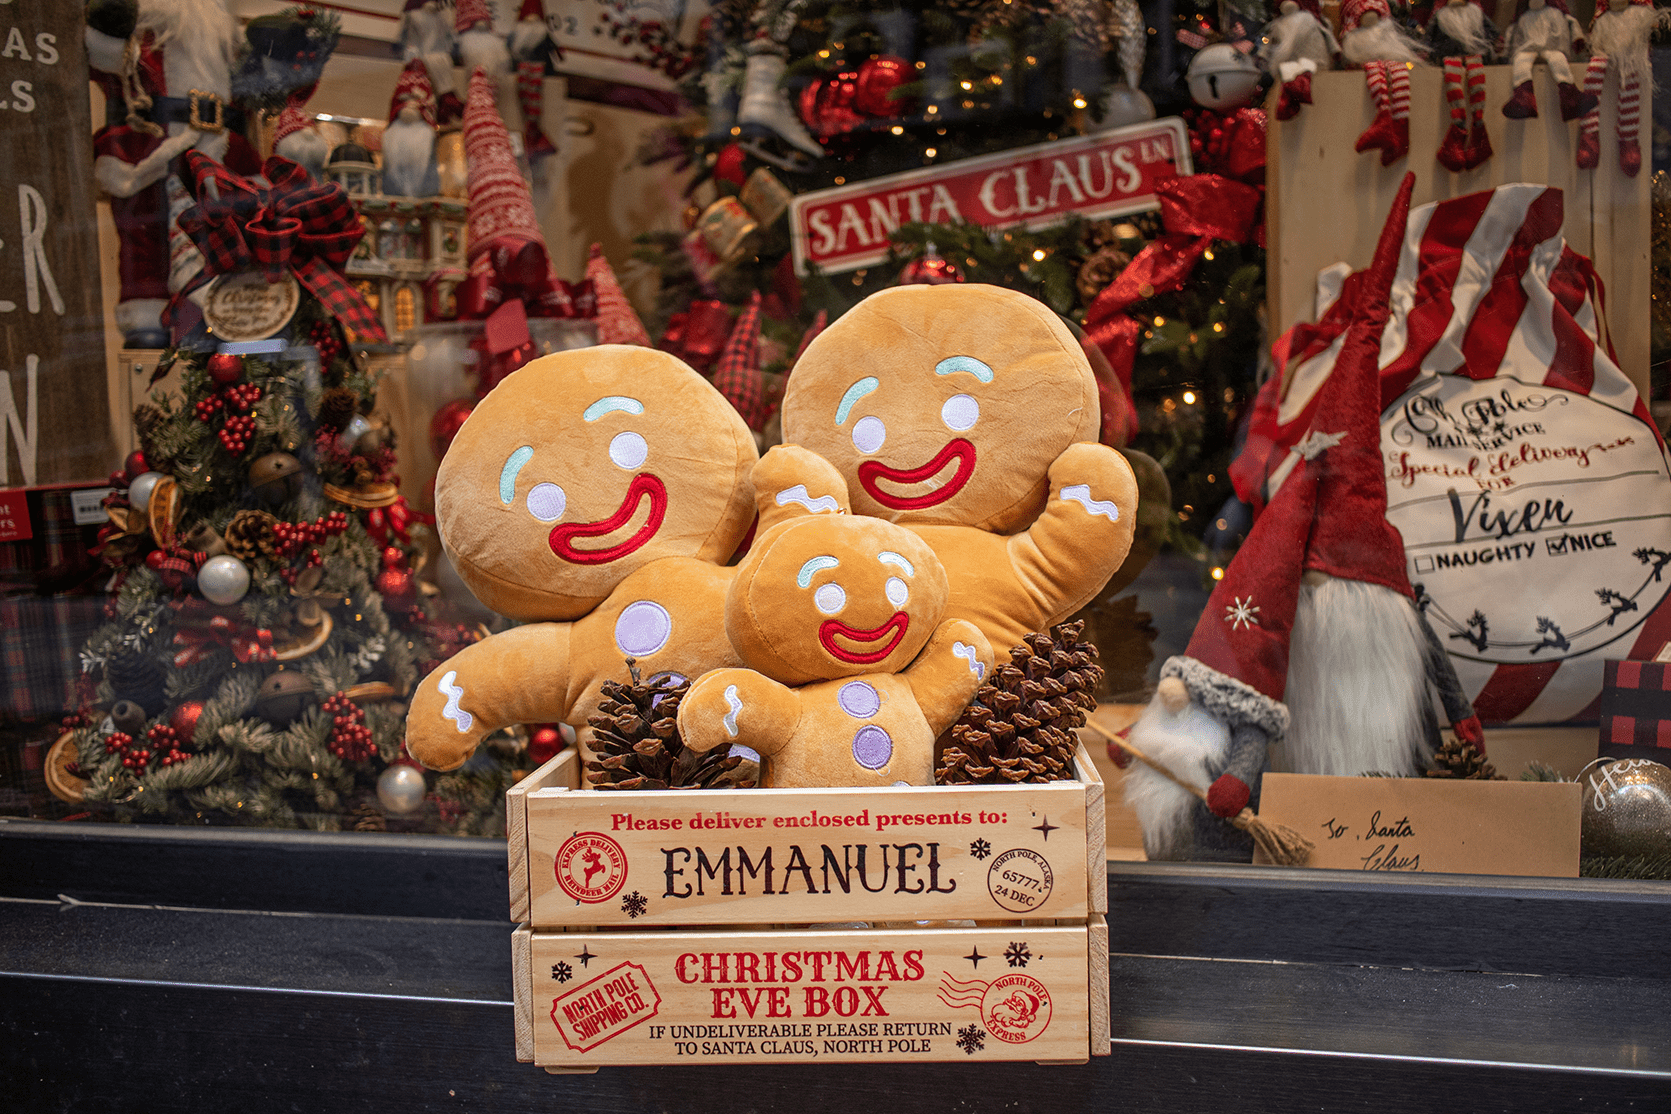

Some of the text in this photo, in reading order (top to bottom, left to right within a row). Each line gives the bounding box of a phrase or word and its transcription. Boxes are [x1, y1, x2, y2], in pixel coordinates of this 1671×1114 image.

[809, 138, 1170, 254] SANTA CLAUS LN
[1388, 451, 1480, 489] Special
[1447, 487, 1573, 543] Vixen
[1436, 541, 1536, 570] NAUGHTY
[1569, 531, 1617, 552] NICE
[611, 808, 1008, 832] Please deliver enclosed presents to:
[562, 839, 621, 869] EXPRESS DELIVERY
[660, 842, 957, 899] EMMANUEL
[992, 851, 1051, 889] NORTH POLE, ALASKA
[1002, 870, 1040, 890] 65777
[564, 873, 619, 897] REINDEER MAIL
[994, 884, 1035, 907] 24 DEC
[674, 949, 925, 985] CHRISTMAS
[562, 971, 640, 1024] NORTH POLE
[709, 985, 890, 1019] EVE BOX
[994, 976, 1048, 1001] NORTH POLE
[572, 992, 650, 1042] SHIPPING CO.
[649, 1022, 952, 1039] IF UNDELIVERABLE PLEASE RETURN
[986, 1018, 1027, 1041] EXPRESS
[674, 1039, 932, 1058] TO SANTA CLAUS, NORTH POLE
